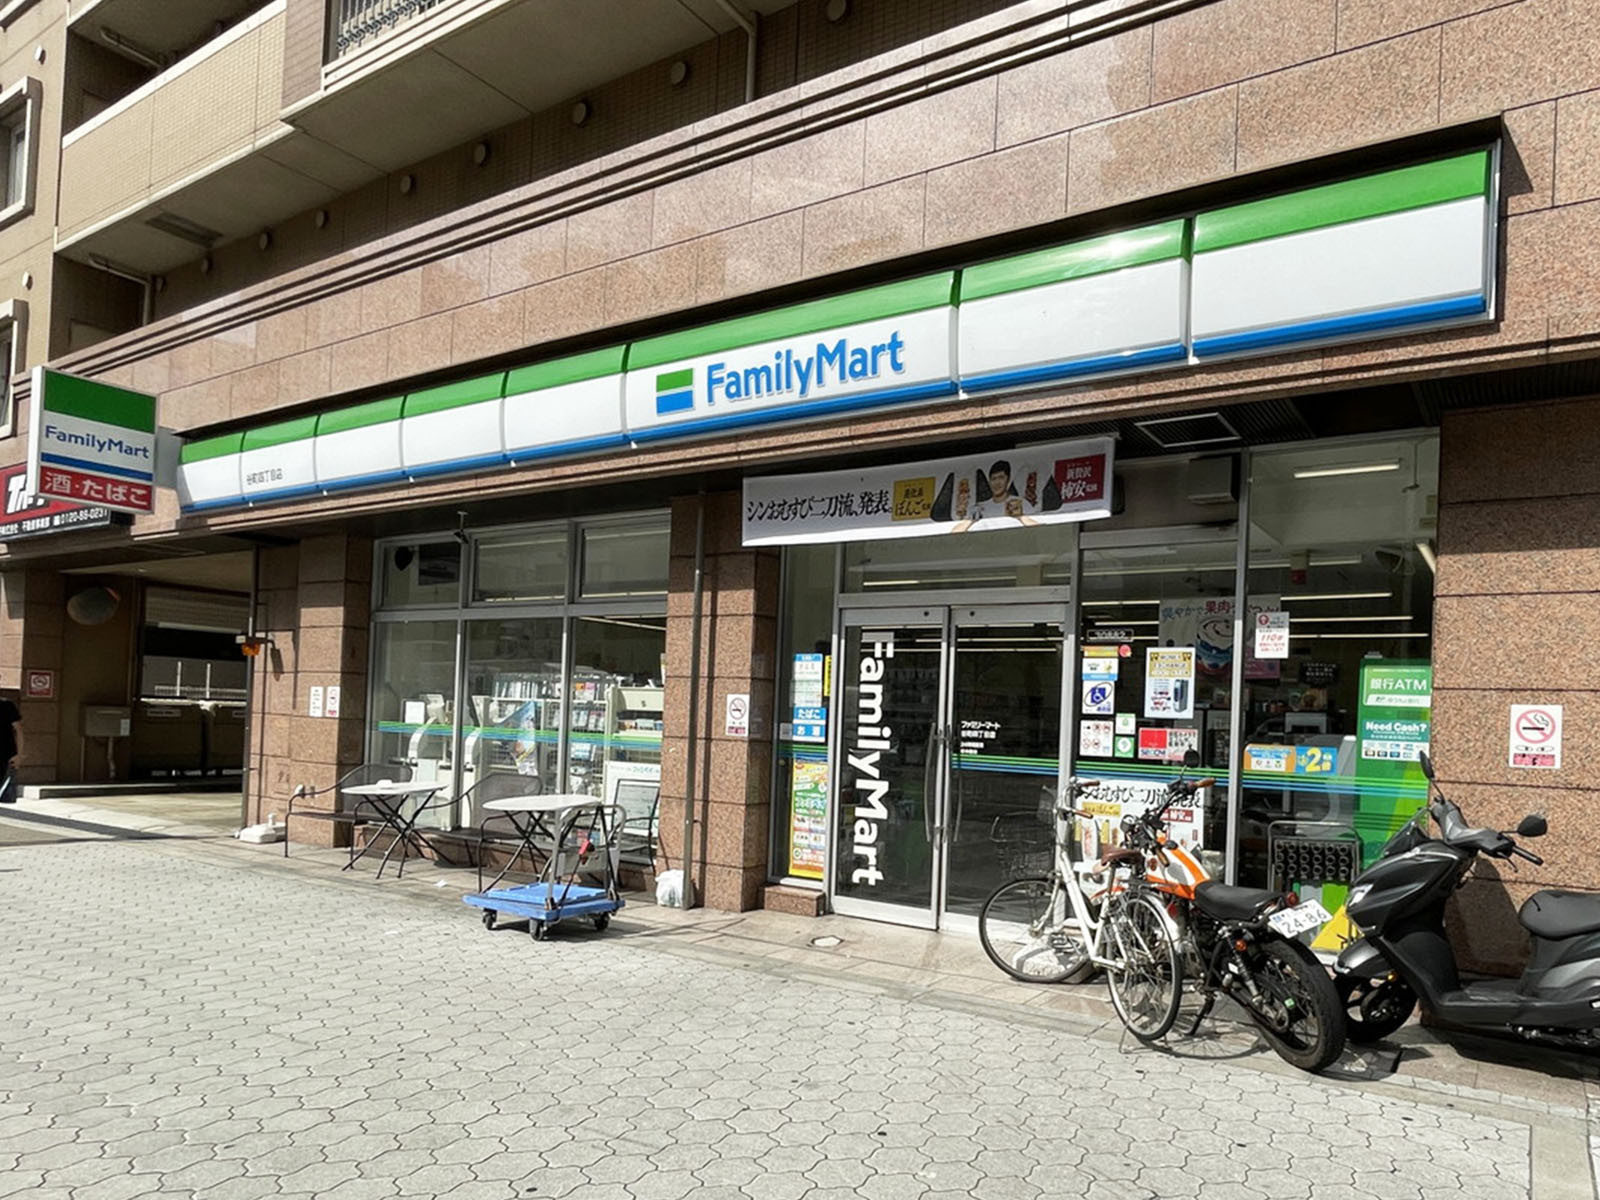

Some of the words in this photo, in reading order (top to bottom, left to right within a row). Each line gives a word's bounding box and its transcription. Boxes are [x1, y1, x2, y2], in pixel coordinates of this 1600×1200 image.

[706, 331, 905, 405] FamilyMart
[44, 425, 150, 460] FamilyMart
[44, 471, 148, 506] 酒・たばこ
[1370, 678, 1427, 691] 銀行ATM
[1365, 721, 1393, 731] Need
[1393, 721, 1428, 732] Cash?
[847, 631, 895, 887] FamilyMart
[1281, 909, 1328, 934] 24-86
